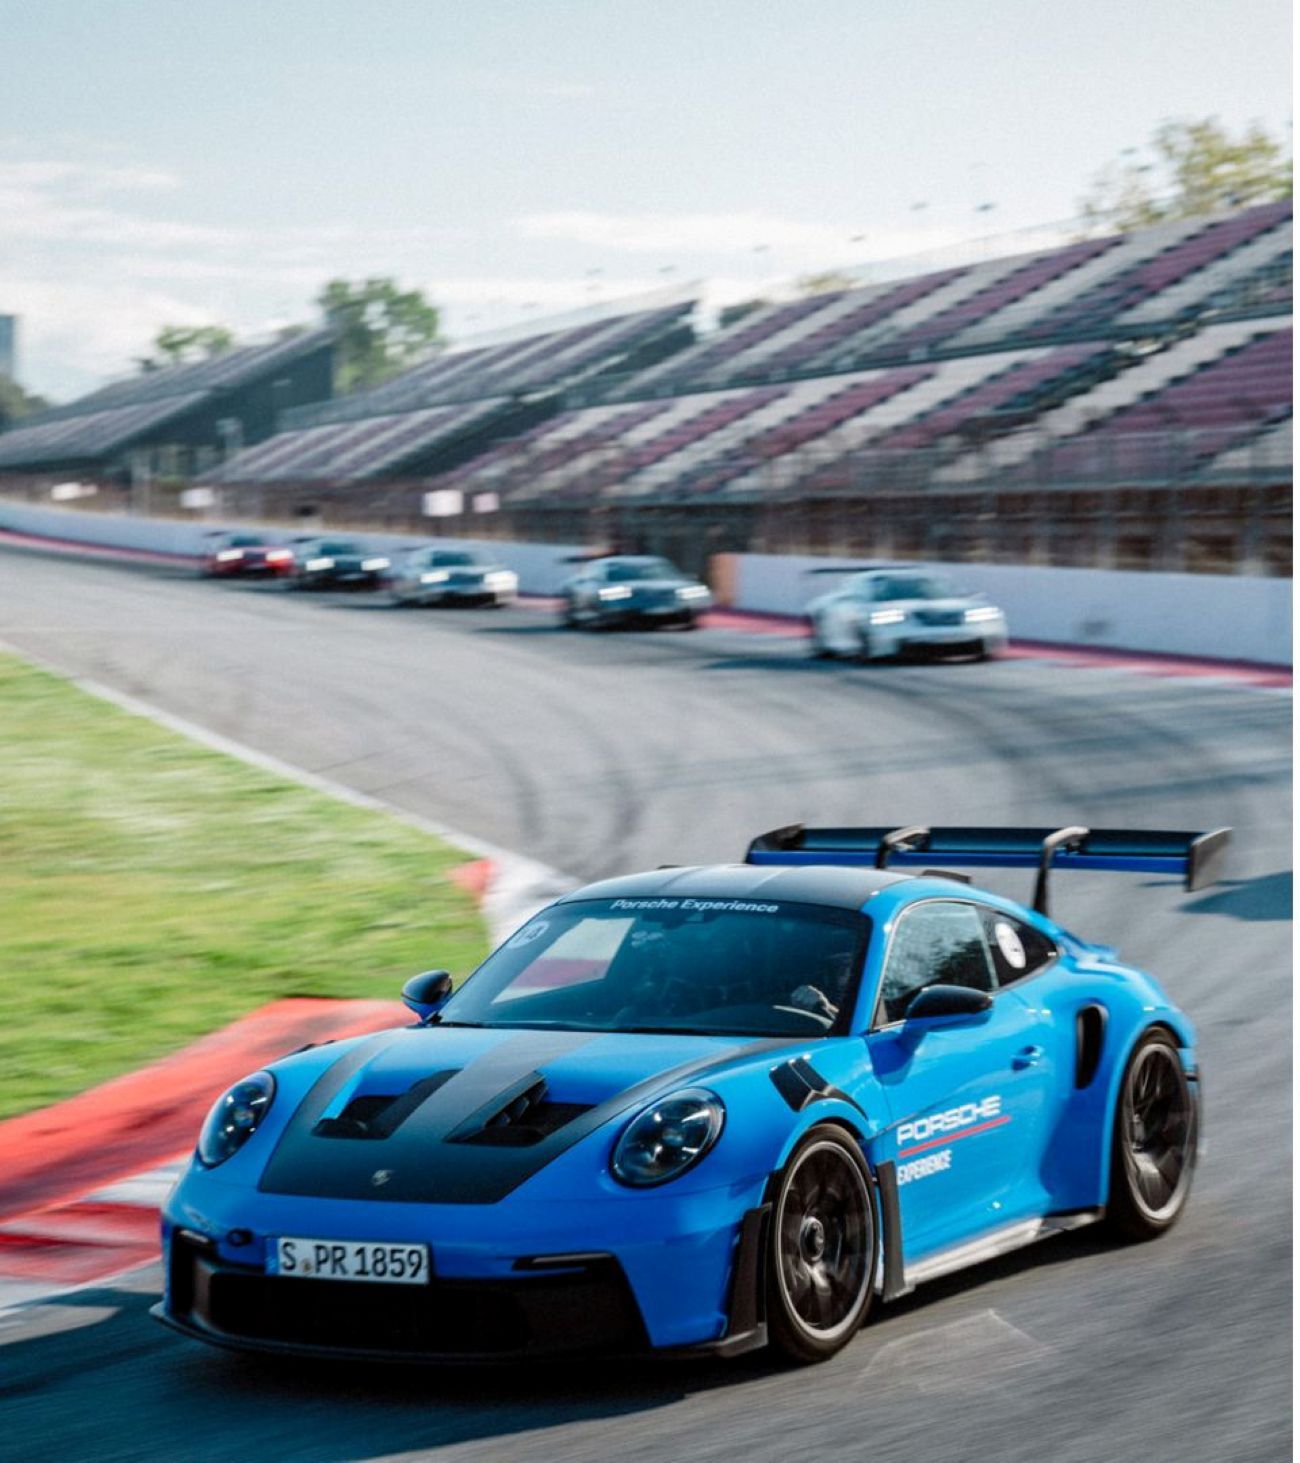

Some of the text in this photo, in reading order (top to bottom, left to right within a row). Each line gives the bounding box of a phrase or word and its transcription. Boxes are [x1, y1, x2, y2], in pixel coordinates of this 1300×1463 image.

[609, 898, 779, 914] Porsche Experience
[896, 1094, 1002, 1146] PORSCHE
[281, 1241, 423, 1278] S PR 1859
